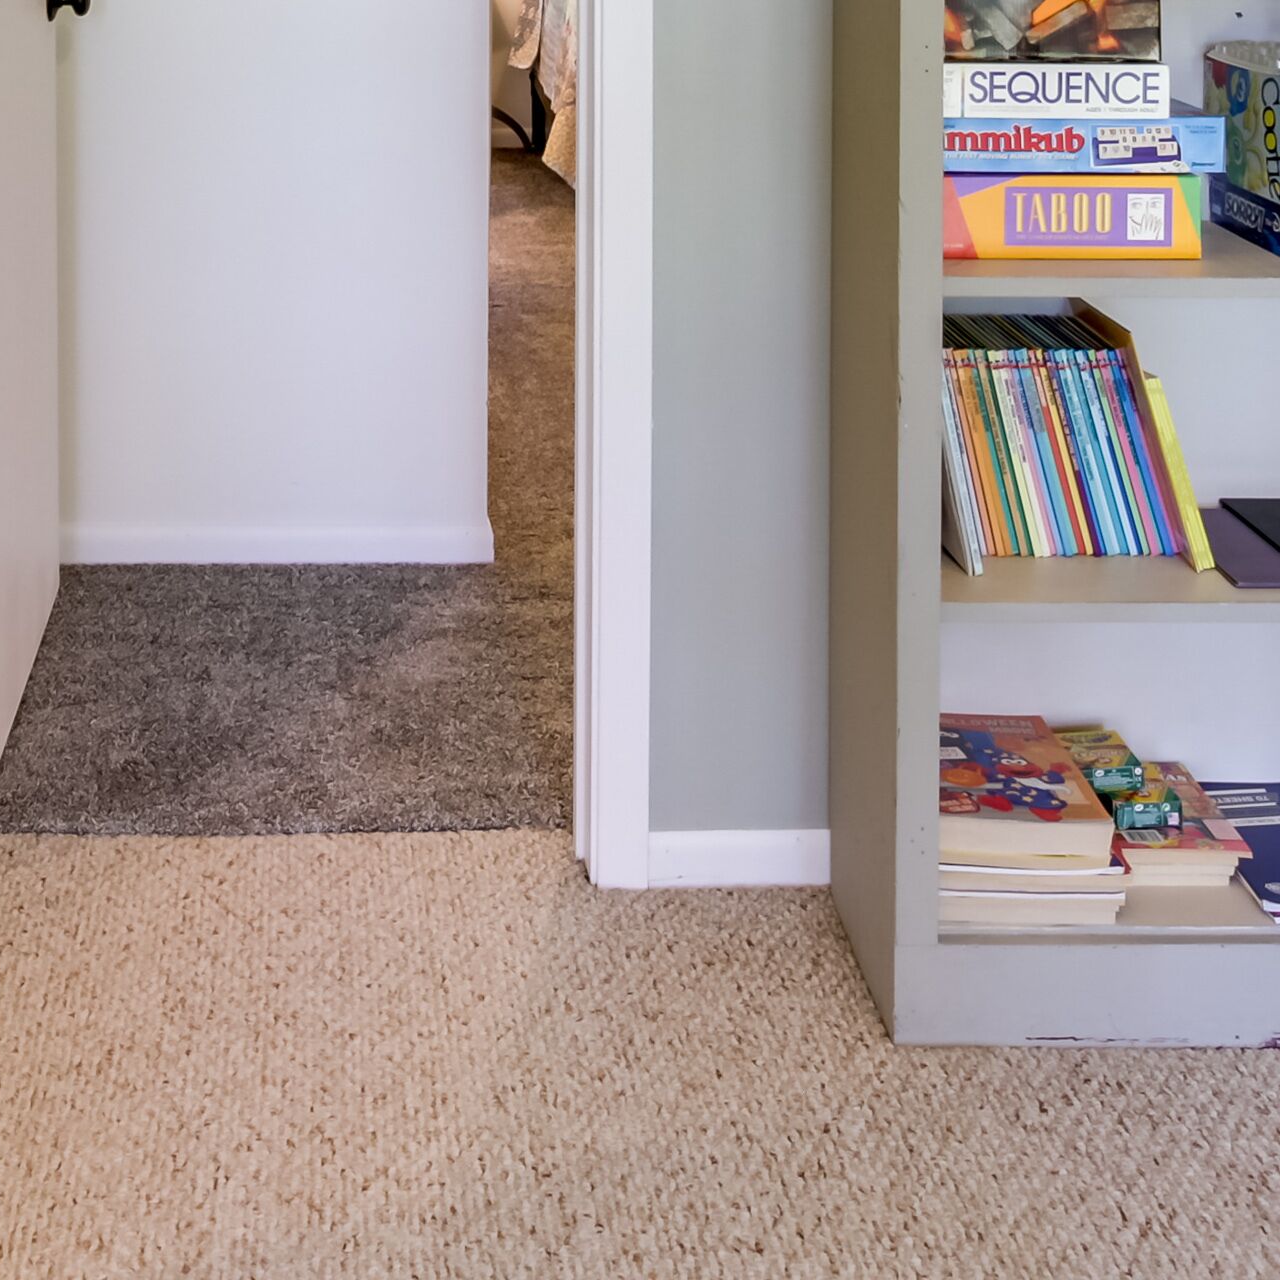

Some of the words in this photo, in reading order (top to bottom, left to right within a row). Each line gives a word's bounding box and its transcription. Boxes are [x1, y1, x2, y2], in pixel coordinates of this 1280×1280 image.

[969, 70, 1160, 104] SEQUENCE
[944, 124, 1086, 154] mmikub
[1012, 192, 1112, 234] TABOO
[1217, 796, 1255, 804] SHEET
